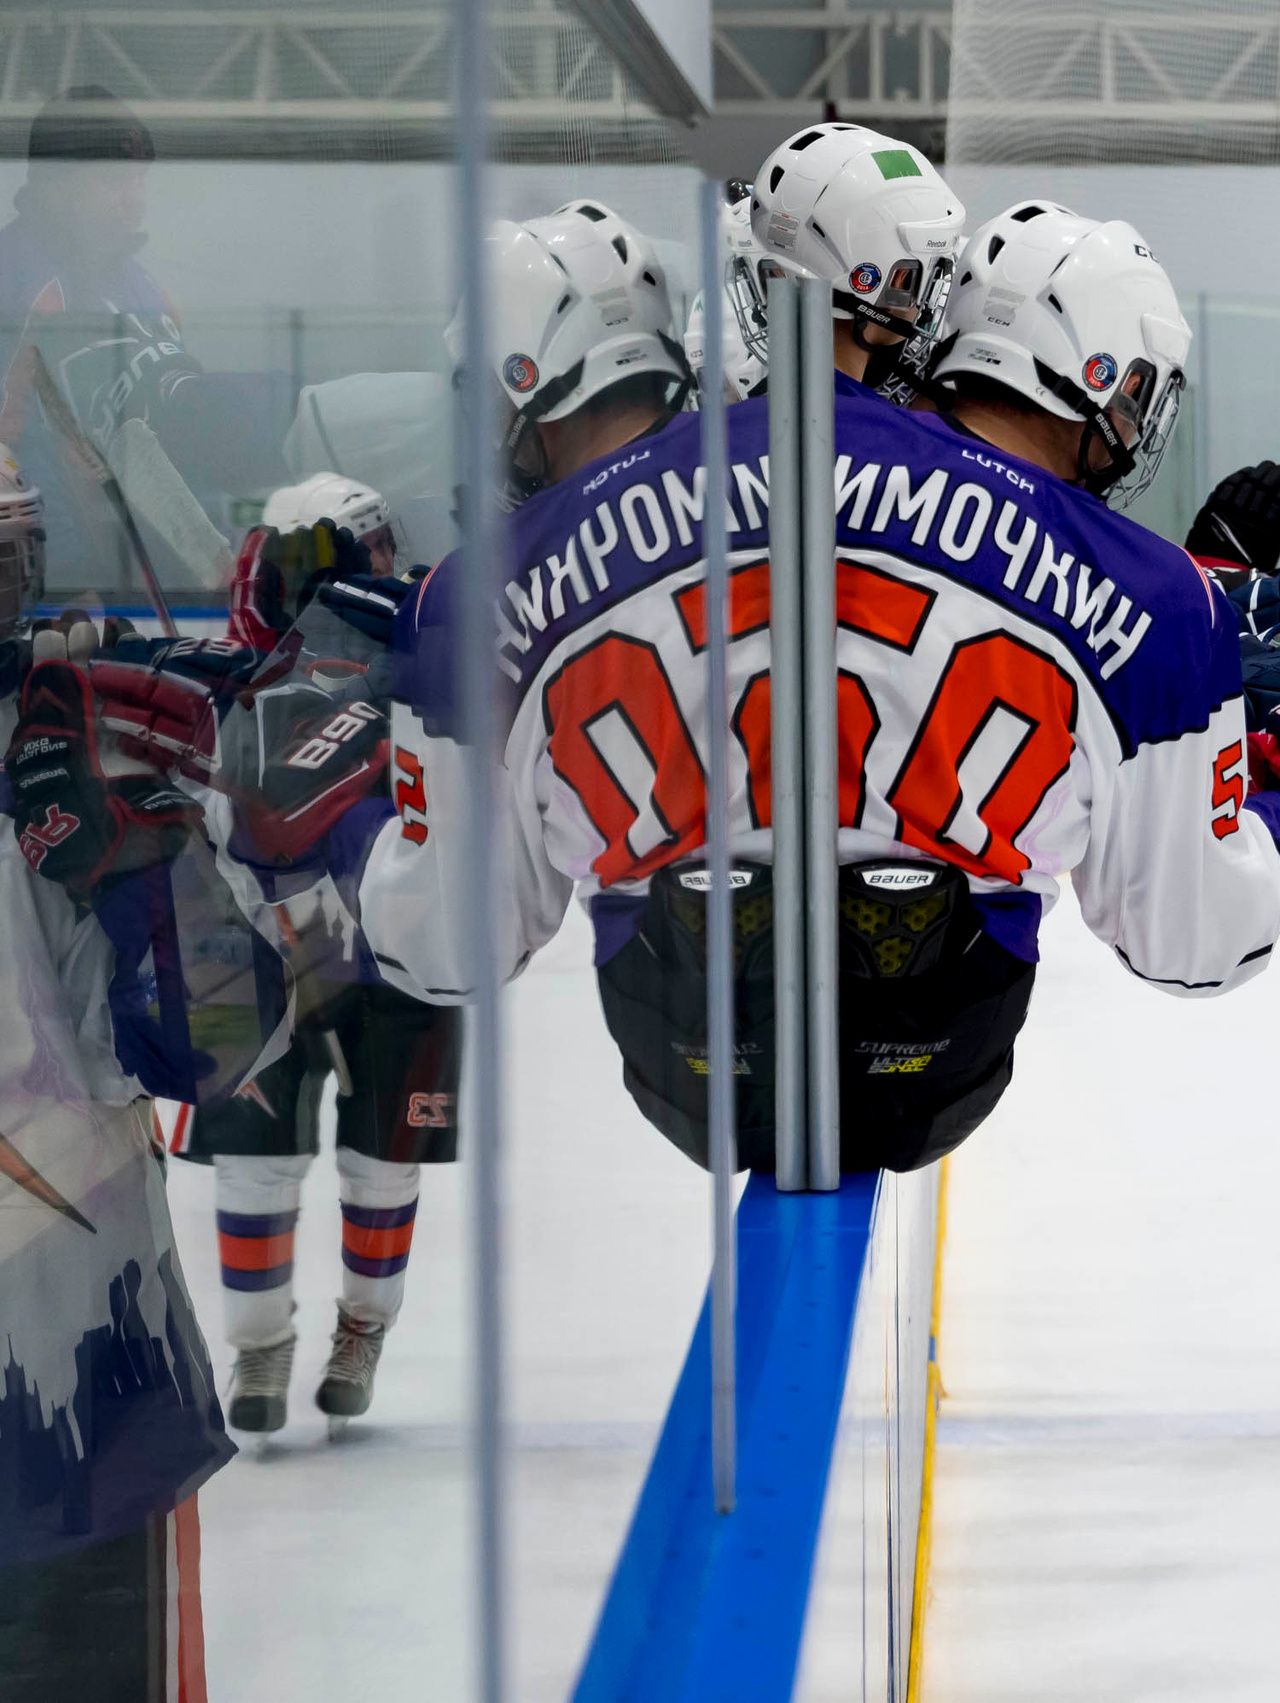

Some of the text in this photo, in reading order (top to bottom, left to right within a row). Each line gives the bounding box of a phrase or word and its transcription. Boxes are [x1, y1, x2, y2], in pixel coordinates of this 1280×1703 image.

[927, 239, 947, 249] Reebok
[1133, 244, 1160, 263] CC
[856, 304, 891, 324] BAUER
[987, 316, 1011, 327] CCM
[1095, 413, 1117, 447] BAUER
[961, 449, 1035, 494] LUTCH
[834, 455, 1153, 681] ИМОЧКИН
[1211, 739, 1245, 841] 5
[868, 875, 929, 885] BAUER
[856, 1038, 950, 1055] SUPREME
